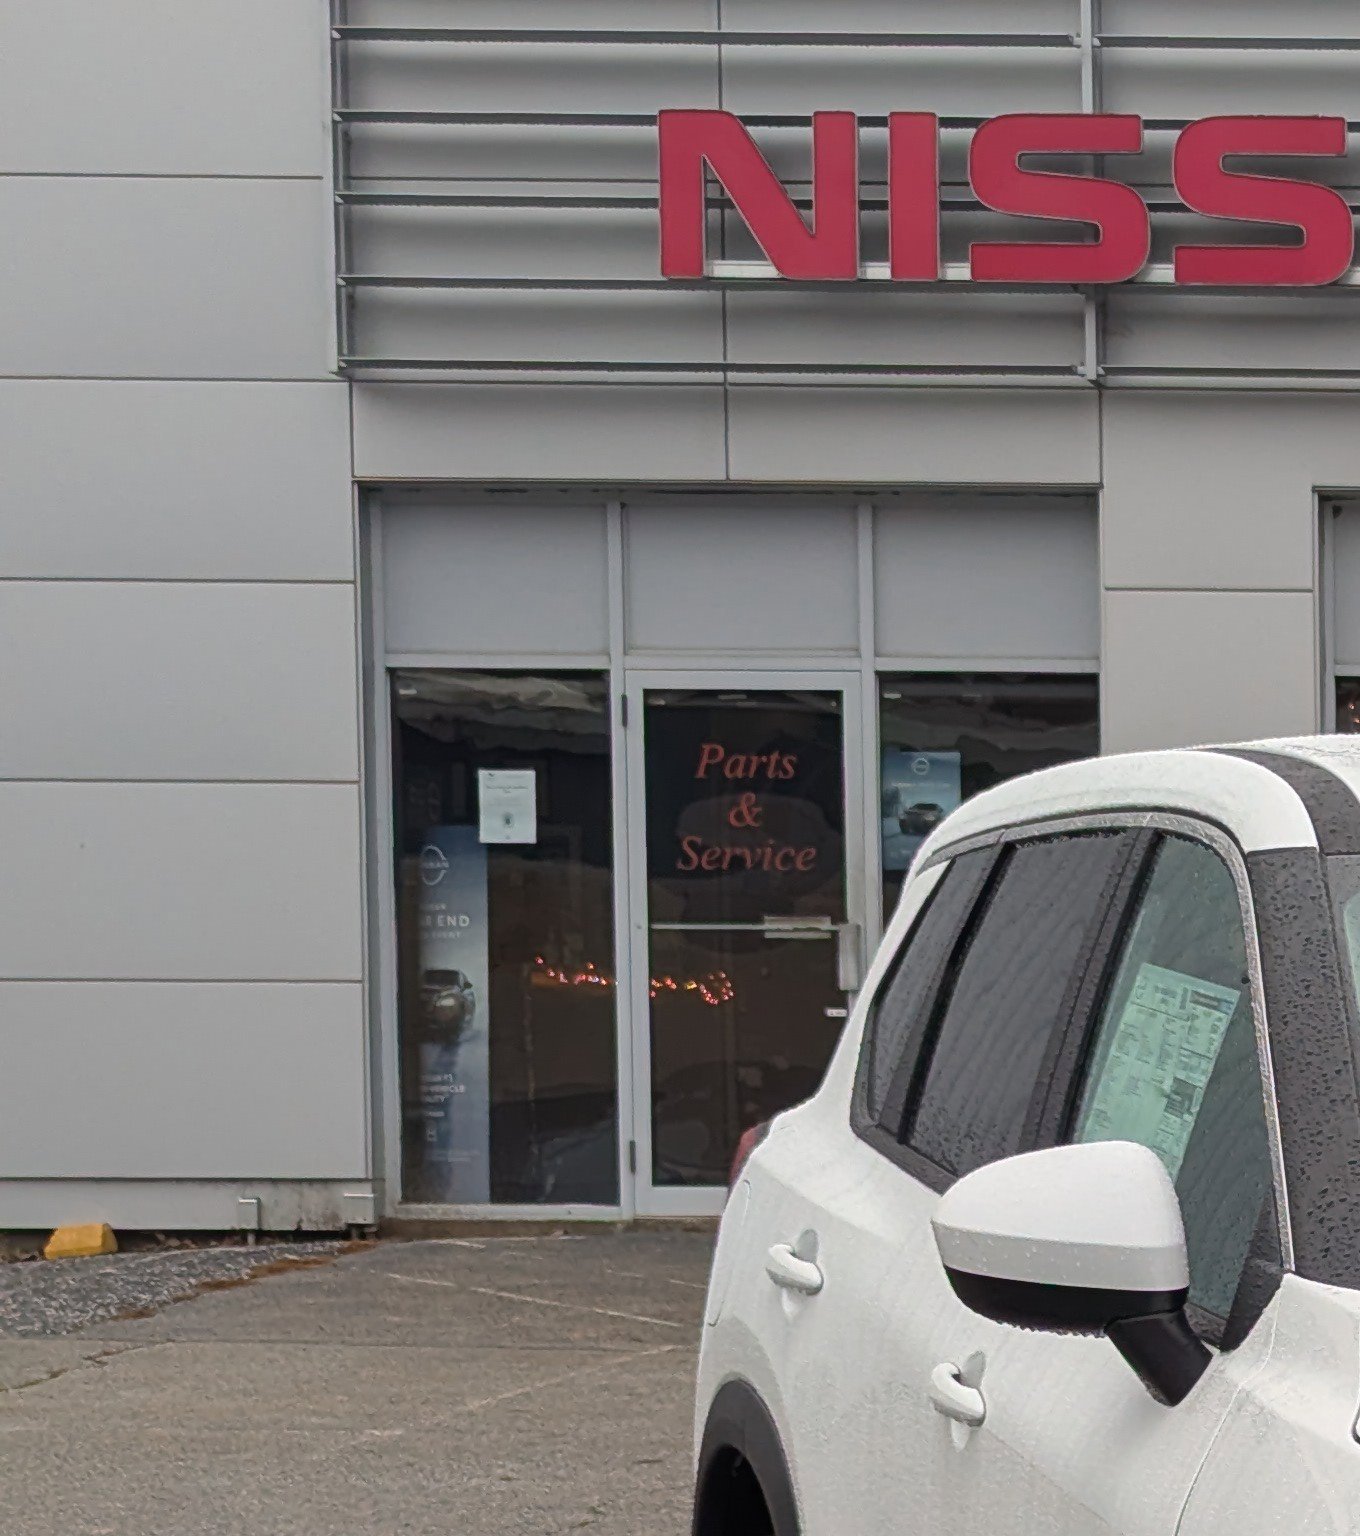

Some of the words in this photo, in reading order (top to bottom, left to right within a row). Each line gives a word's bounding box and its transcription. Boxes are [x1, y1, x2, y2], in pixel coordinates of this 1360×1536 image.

[694, 743, 798, 780] Parts
[729, 792, 763, 828] &
[676, 835, 817, 871] Service
